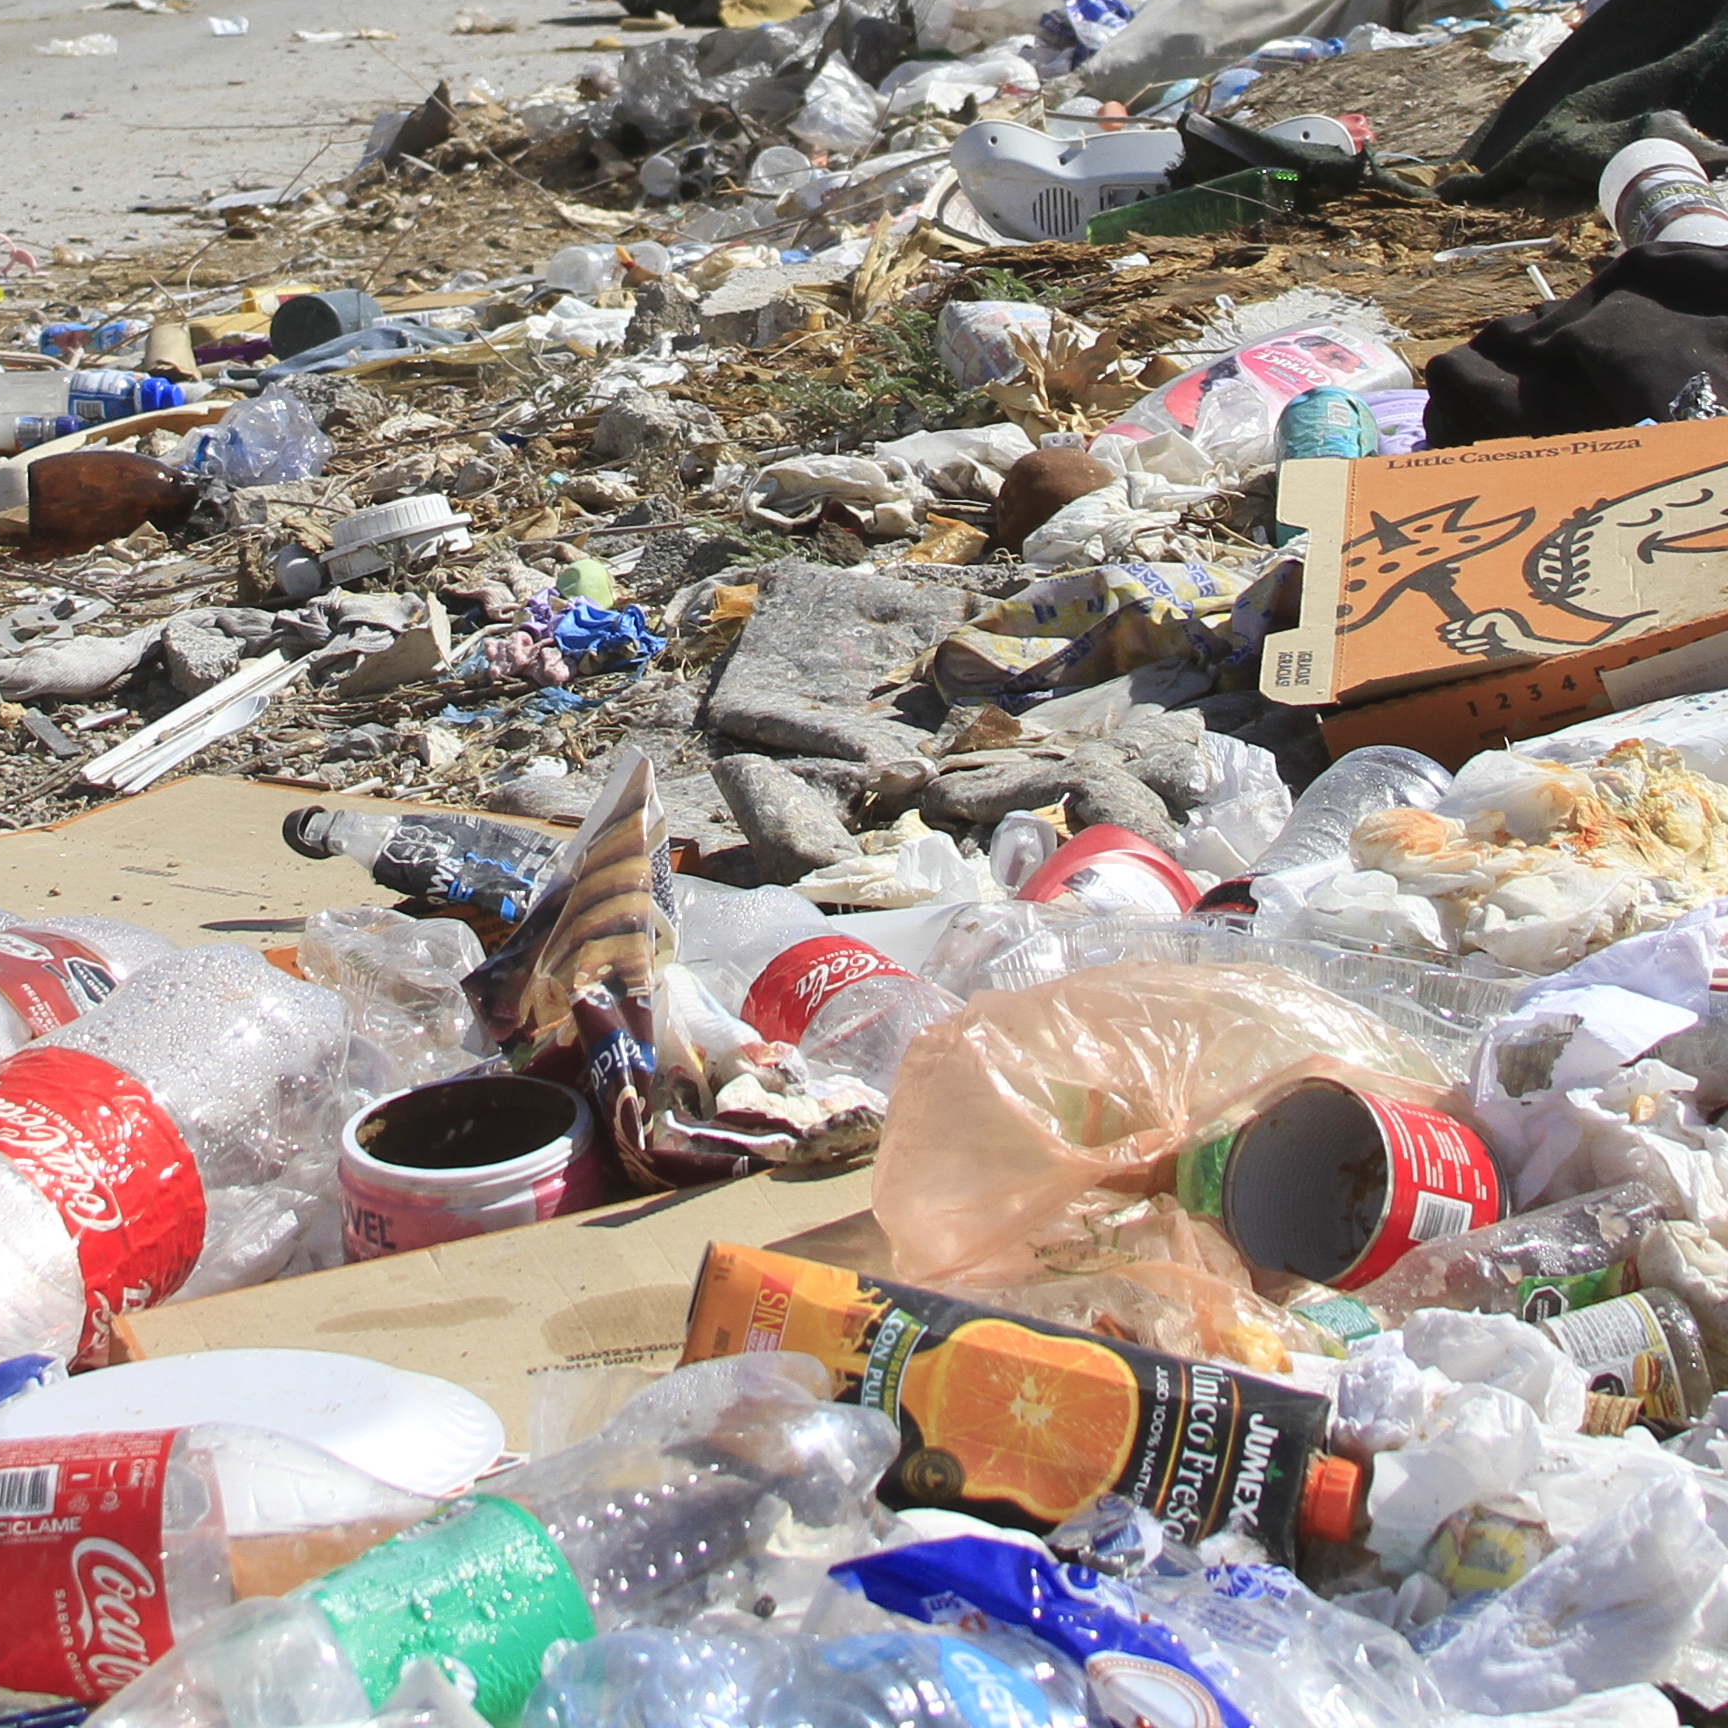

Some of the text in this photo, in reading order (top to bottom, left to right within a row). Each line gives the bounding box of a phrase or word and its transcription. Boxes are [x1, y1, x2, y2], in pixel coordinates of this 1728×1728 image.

[1251, 350, 1333, 387] CAPRICE
[1386, 437, 1643, 471] Little Caesars Pizza
[1467, 700, 1480, 718] 1
[1495, 692, 1512, 711] 2
[1527, 683, 1543, 702] 3
[1561, 674, 1578, 693] 4
[751, 1288, 790, 1334] SIN
[872, 1317, 906, 1363] CON
[1155, 1365, 1170, 1403] JUGO
[1186, 1364, 1231, 1446] Único
[1146, 1404, 1167, 1449] 100%
[1228, 1412, 1280, 1527] JUMEX
[54, 1588, 74, 1649] SABOR
